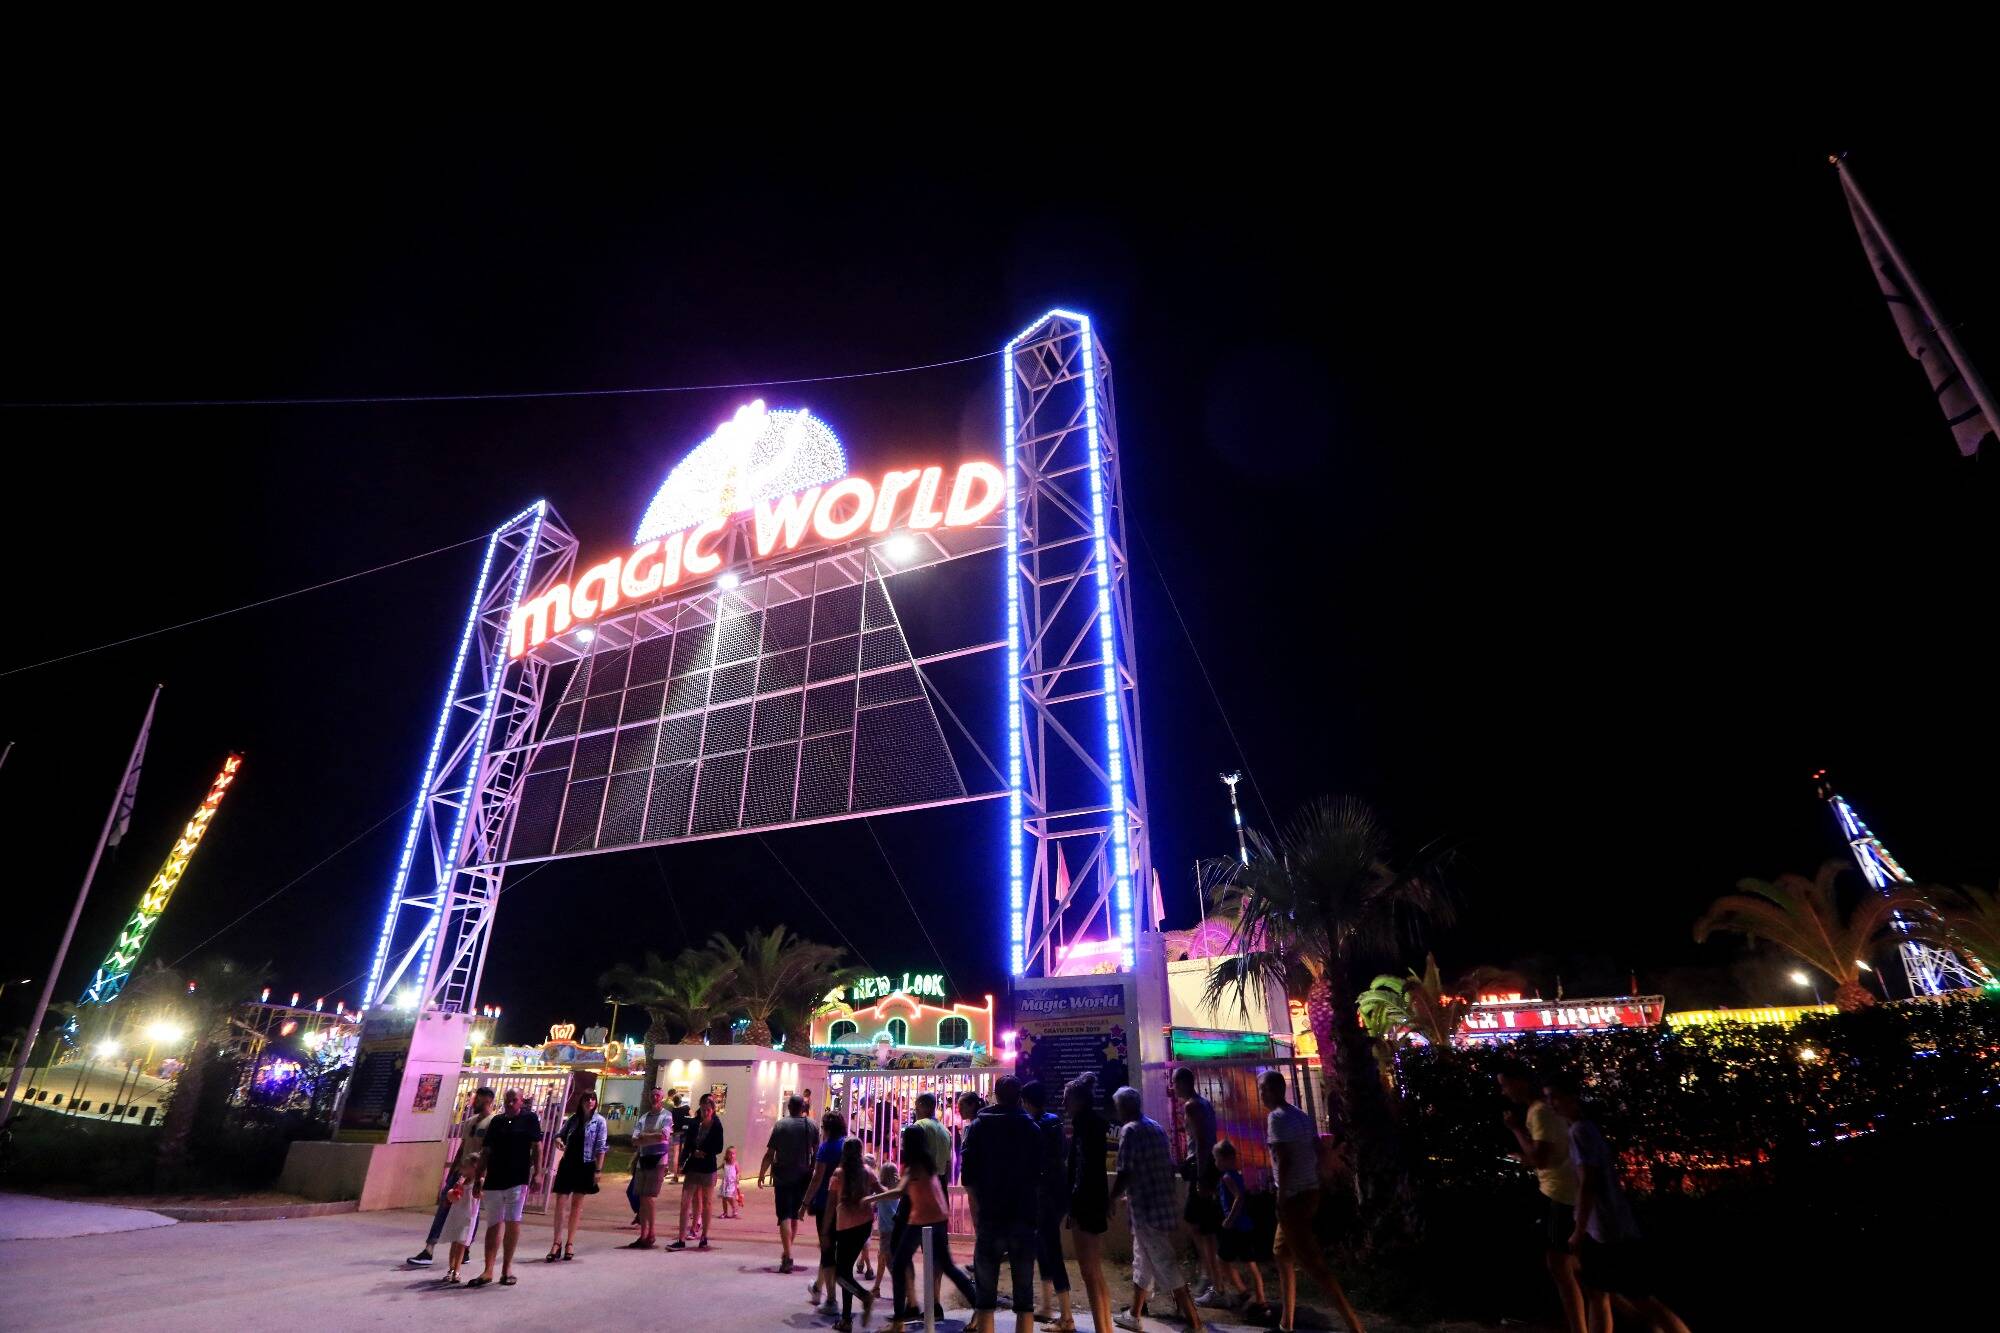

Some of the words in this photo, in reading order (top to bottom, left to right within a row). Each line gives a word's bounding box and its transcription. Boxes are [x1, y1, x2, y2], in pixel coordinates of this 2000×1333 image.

[853, 975, 891, 999] NEW
[901, 972, 945, 997] LOOK
[1021, 994, 1067, 1014] Magic
[1069, 994, 1119, 1009] World
[1043, 1026, 1074, 1034] GRATUITS
